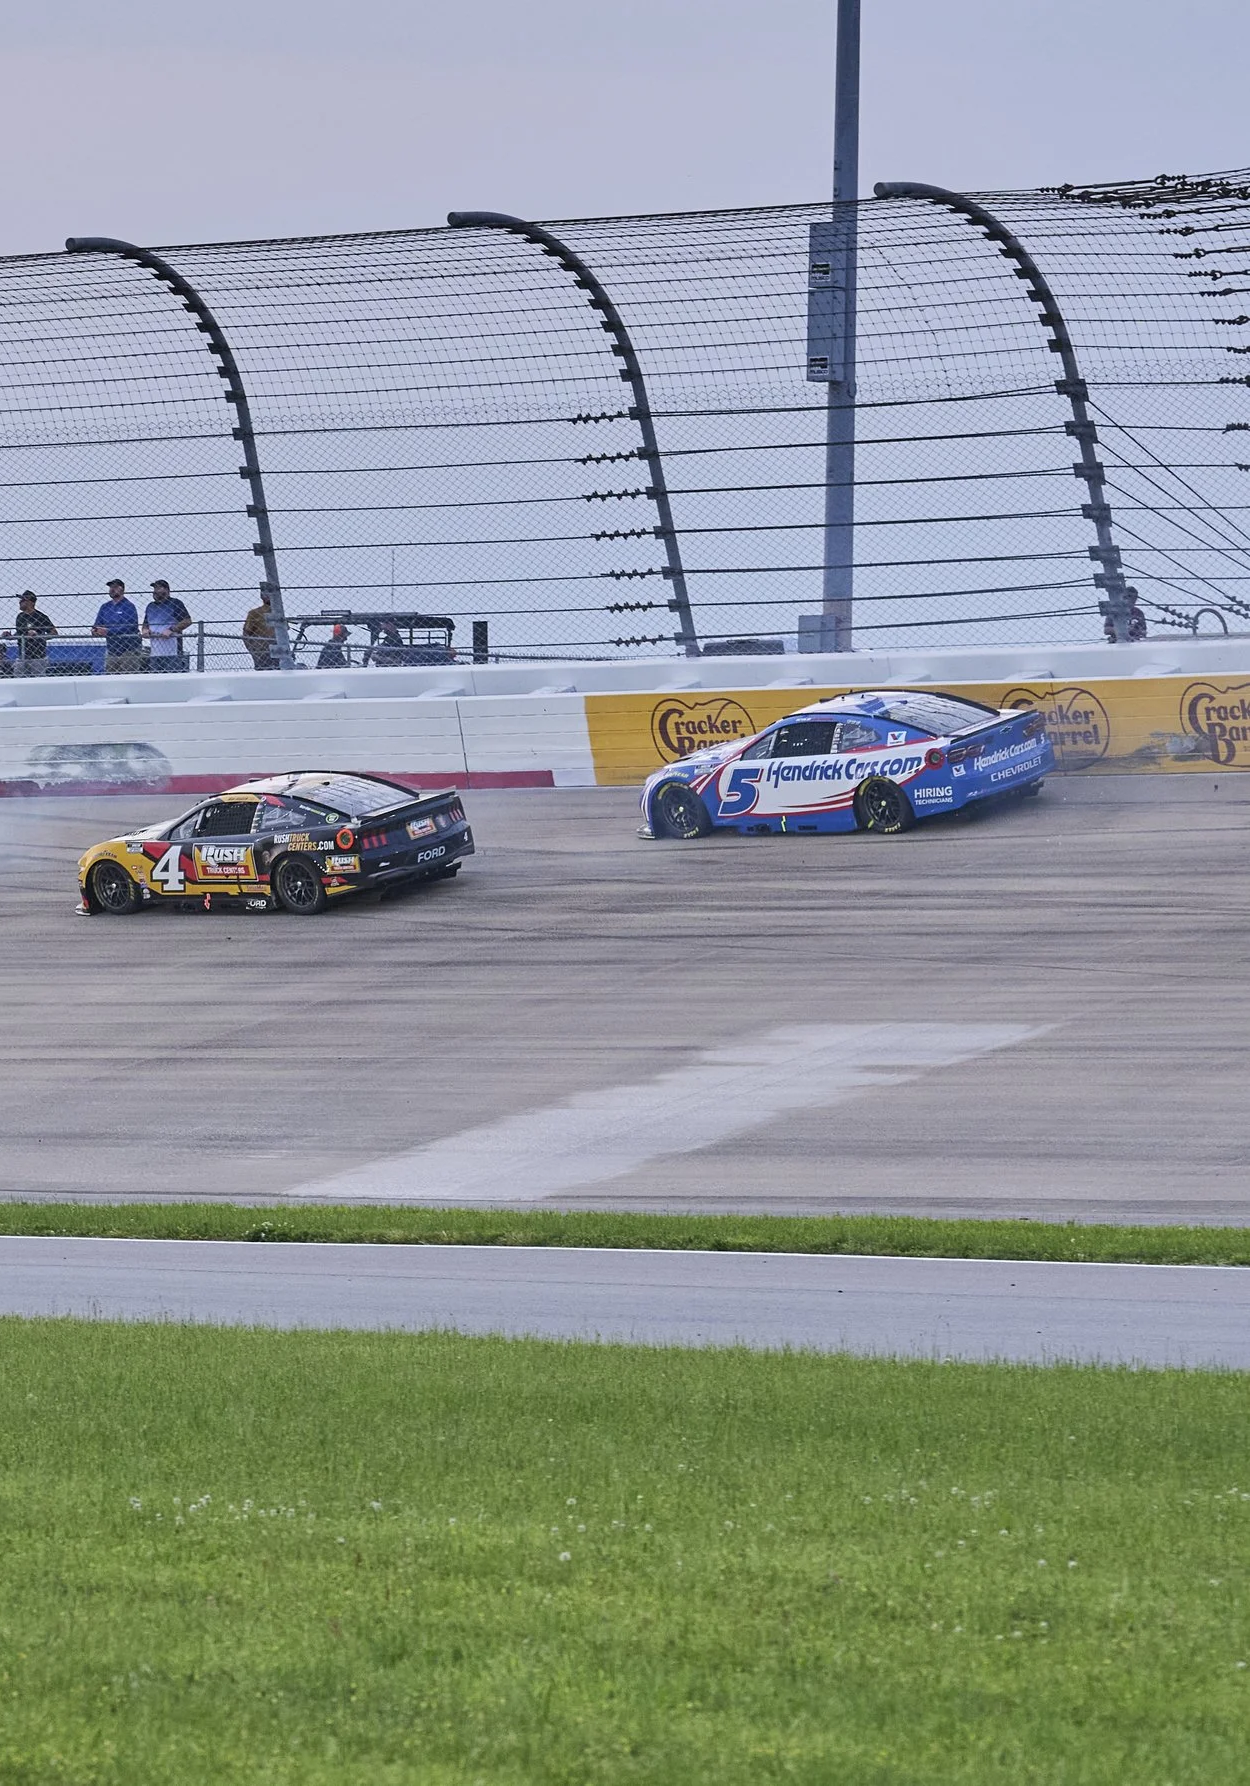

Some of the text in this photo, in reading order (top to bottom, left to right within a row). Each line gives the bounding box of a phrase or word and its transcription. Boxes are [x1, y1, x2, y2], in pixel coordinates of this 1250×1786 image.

[1188, 693, 1250, 737] Crack
[658, 708, 742, 756] Cracker
[990, 755, 1042, 782] CHEVROLET
[718, 766, 763, 817] 5
[914, 786, 953, 799] HIRING
[915, 797, 953, 806] TECHNICIANS
[463, 831, 469, 842] 4
[200, 845, 248, 867] RUSH
[417, 845, 446, 863] FORD
[152, 845, 186, 891] 4
